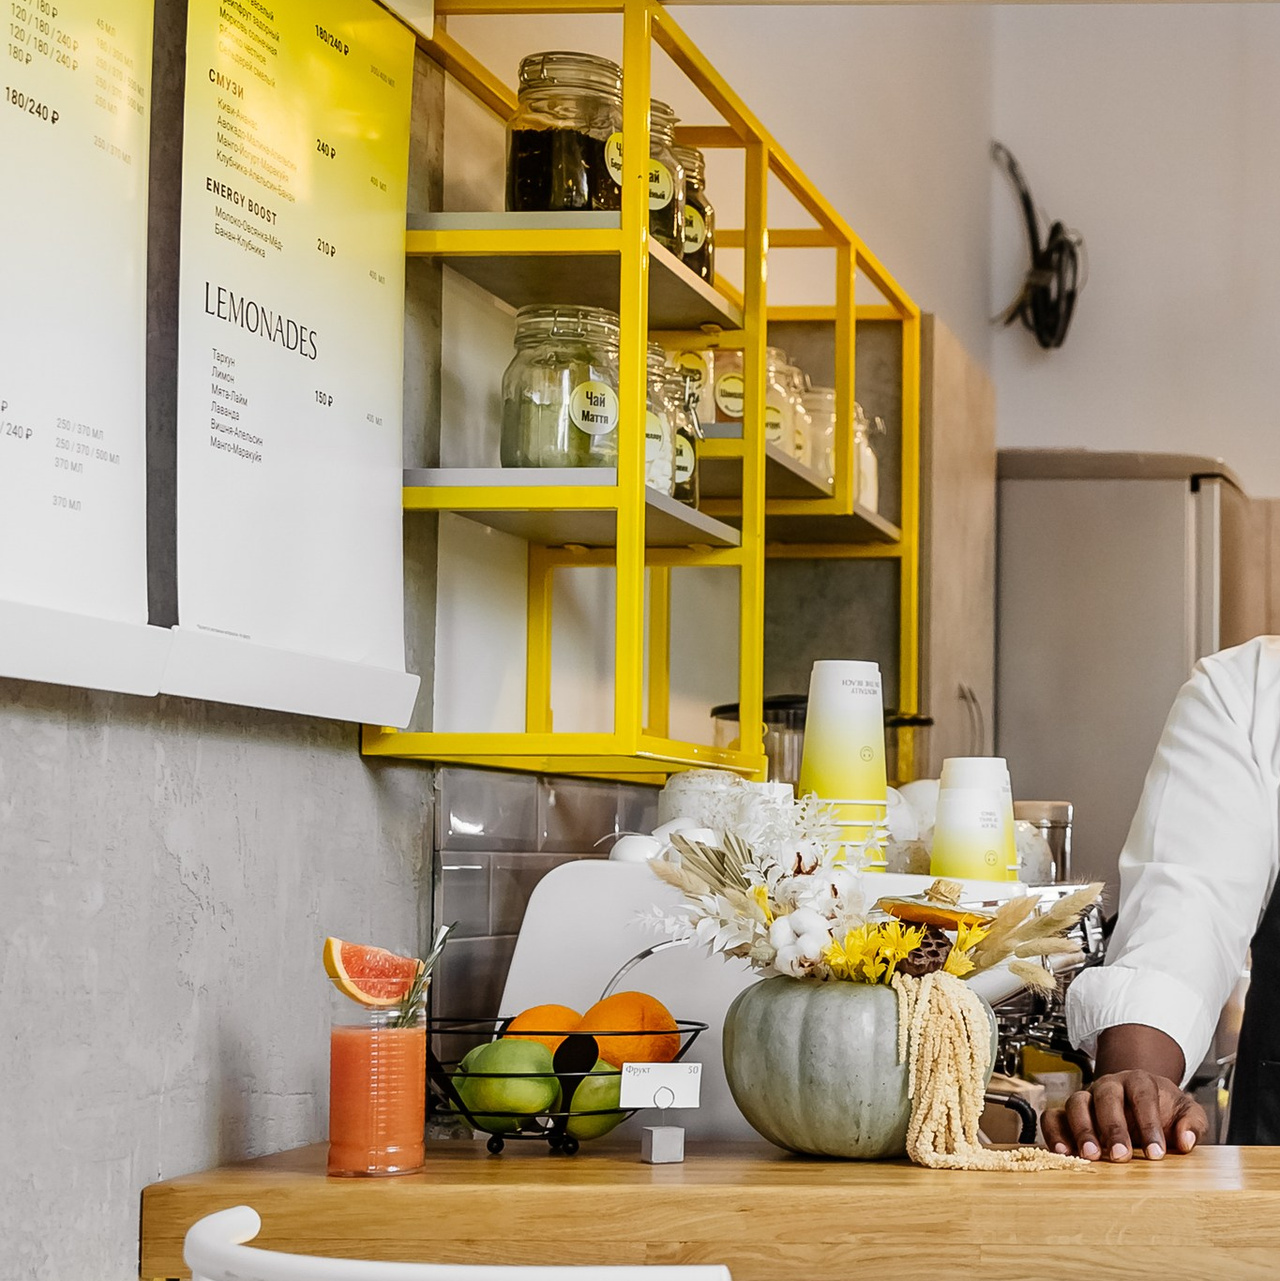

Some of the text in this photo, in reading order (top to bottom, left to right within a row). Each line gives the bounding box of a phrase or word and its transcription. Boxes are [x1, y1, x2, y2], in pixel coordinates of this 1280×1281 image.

[11, 2, 72, 50] 120 180 240
[10, 23, 71, 69] 120 180 240
[315, 24, 343, 53] 180/240
[8, 43, 24, 62] 180
[208, 68, 244, 100] СМУЗИ
[5, 86, 49, 121] 180/240
[316, 139, 330, 156] 240
[649, 170, 660, 184] ай
[206, 176, 278, 226] ENERGY BOOST
[317, 238, 330, 255] 210
[205, 281, 318, 361] LEMONADES
[212, 348, 236, 369] Тархун
[211, 366, 235, 385] Лимон
[211, 383, 248, 407] Мята-Лайм
[315, 390, 327, 406] 150
[586, 391, 605, 408] Чай
[211, 401, 240, 421] Лаванда
[581, 410, 608, 424] Маття
[6, 422, 24, 439] 240
[210, 418, 264, 447] Вишня-Апельсин
[210, 436, 262, 464] Манго-Маракуйя
[625, 1065, 699, 1077] Фрукт 50
